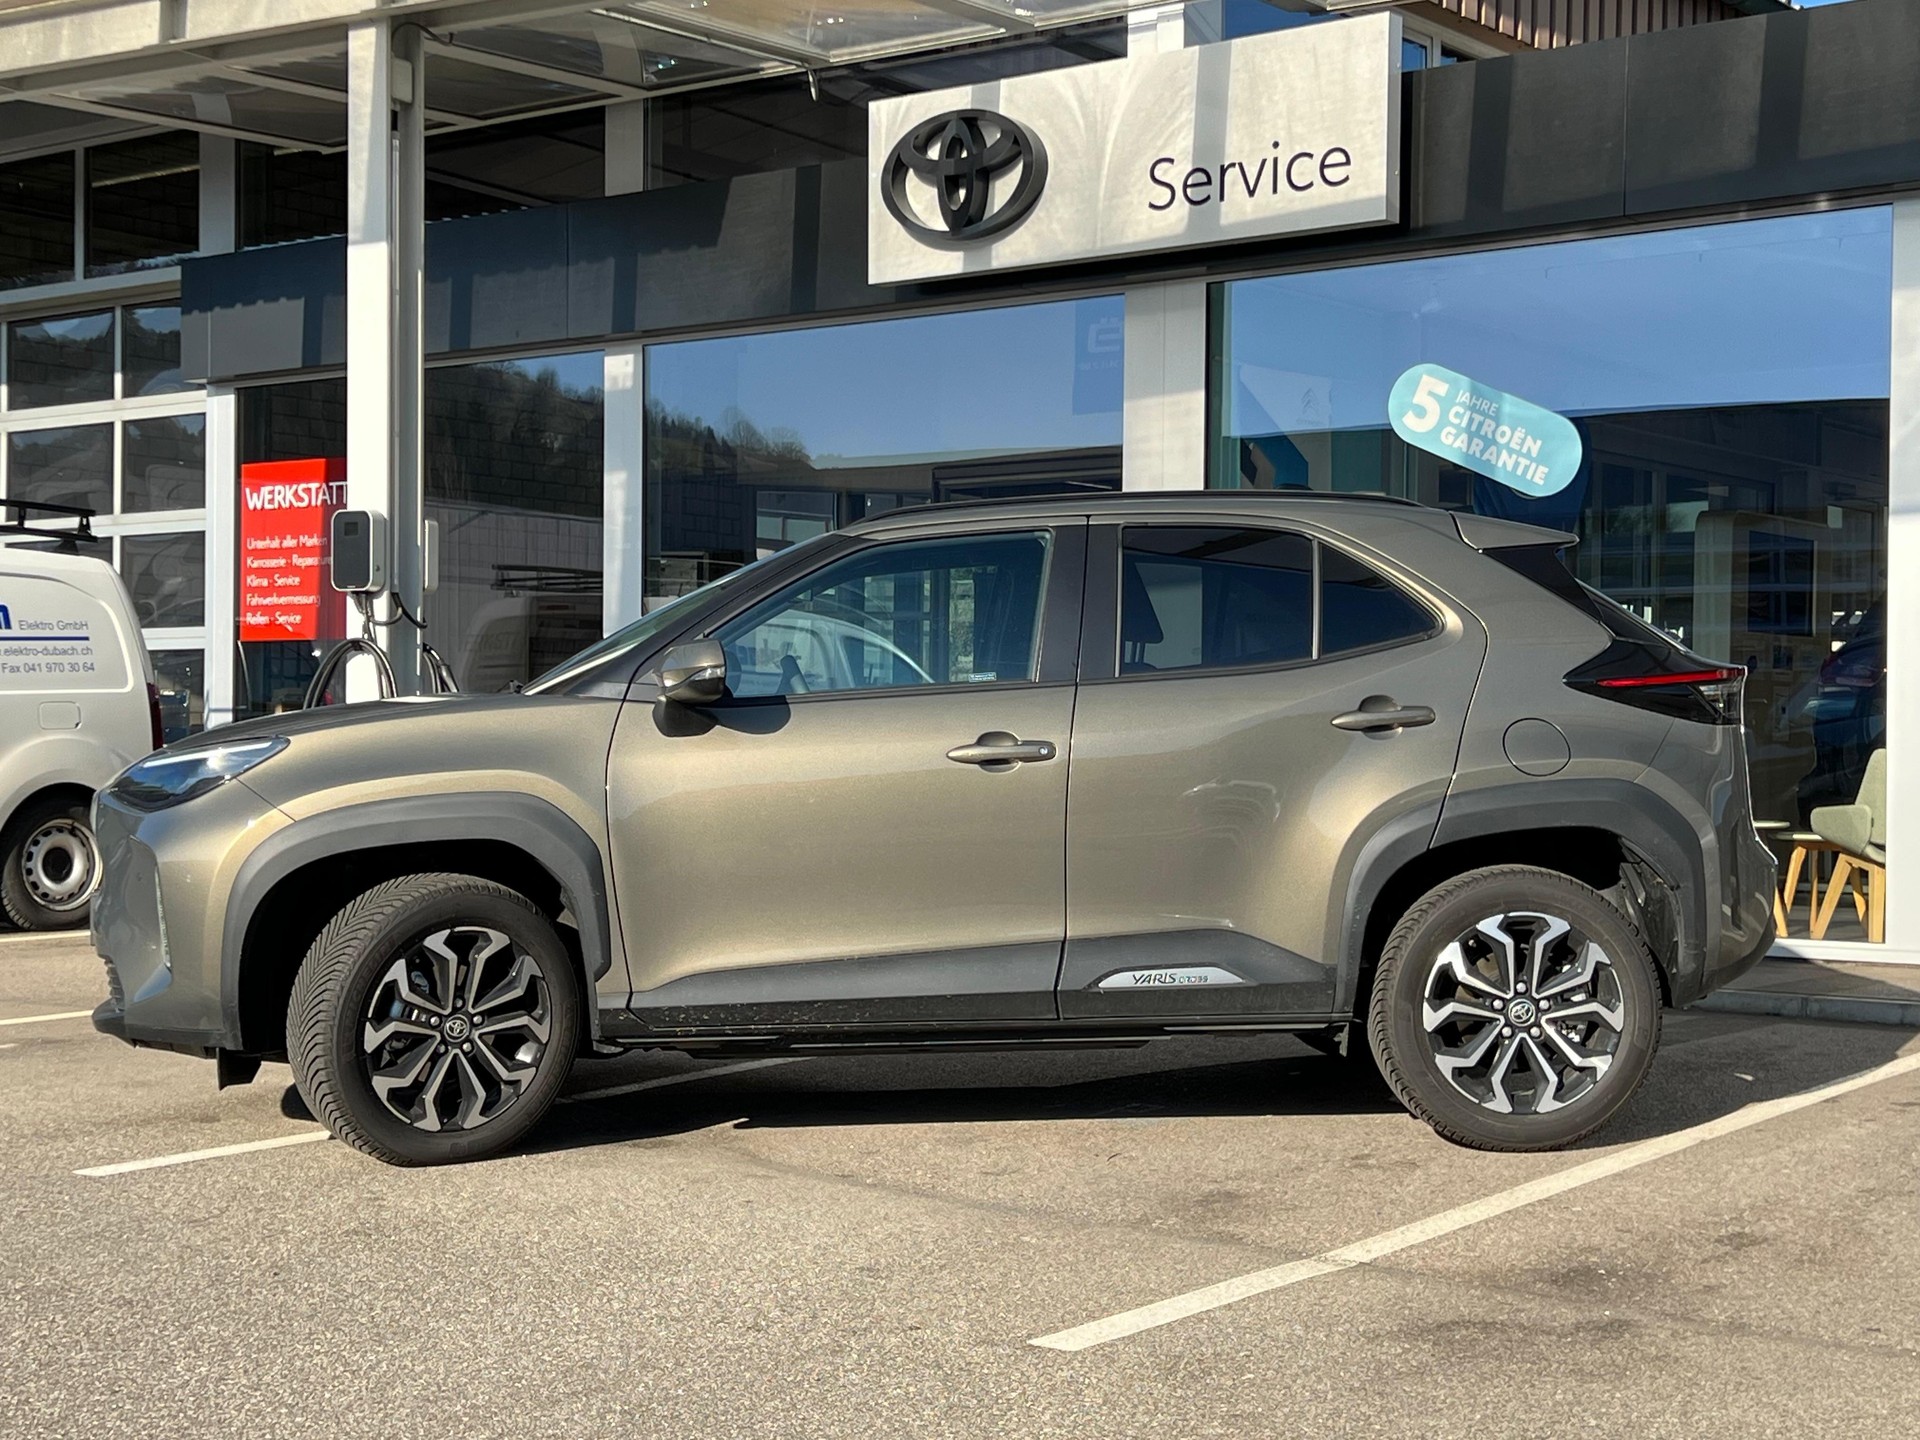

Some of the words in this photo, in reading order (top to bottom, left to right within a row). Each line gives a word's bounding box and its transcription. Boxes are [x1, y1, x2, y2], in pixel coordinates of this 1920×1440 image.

[1148, 140, 1351, 211] Service
[1402, 373, 1449, 433] 5
[1456, 389, 1499, 417] JAHRE
[1448, 405, 1543, 458] CITROËN
[1440, 426, 1549, 486] GARANTIE
[245, 481, 348, 511] WERKSTATT
[246, 574, 269, 587] Klima
[274, 573, 301, 587] Service
[18, 620, 54, 631] Elektro
[56, 620, 89, 631] GmbH
[275, 611, 302, 625] Service
[1, 662, 20, 673] Fax
[23, 662, 42, 673] 041
[45, 662, 65, 673] 970
[68, 662, 80, 672] 30
[82, 662, 95, 672] 64
[1132, 972, 1177, 985] YARIS
